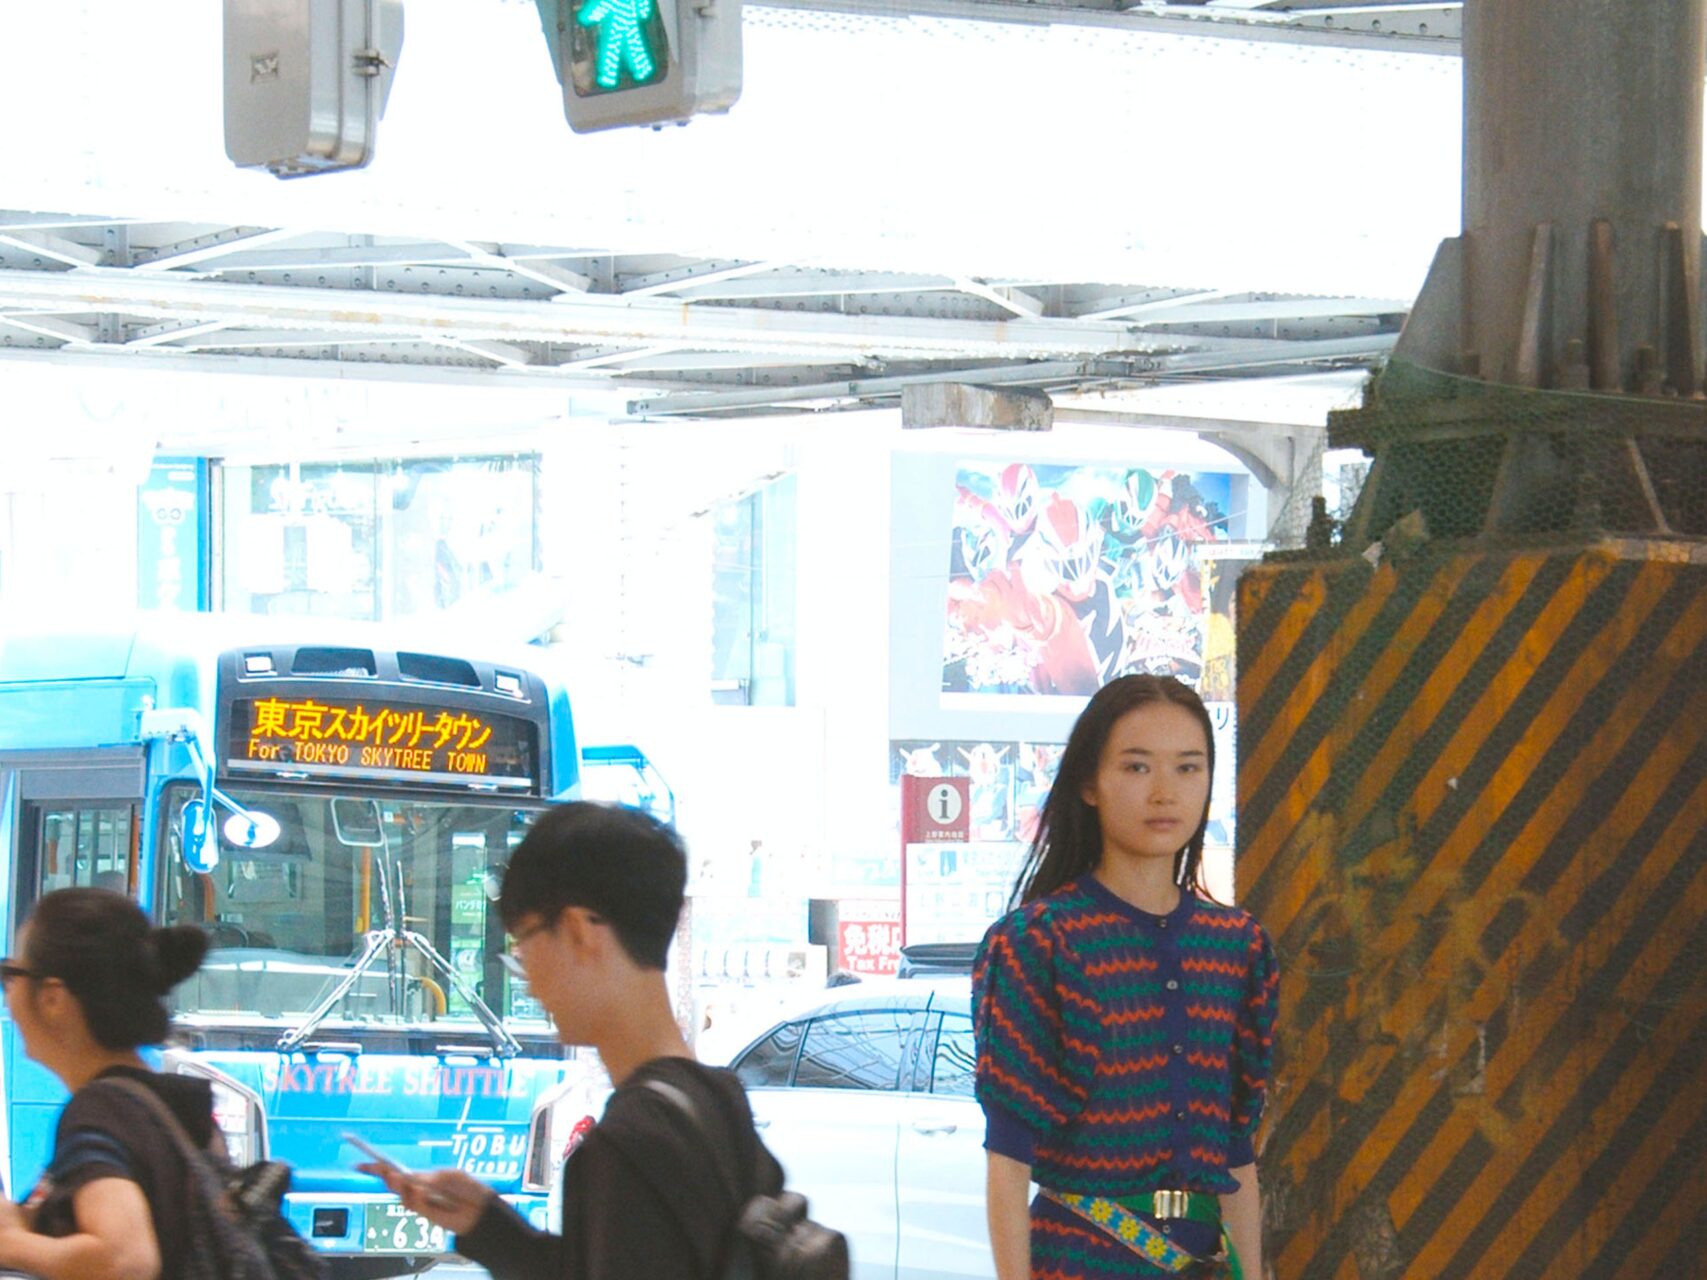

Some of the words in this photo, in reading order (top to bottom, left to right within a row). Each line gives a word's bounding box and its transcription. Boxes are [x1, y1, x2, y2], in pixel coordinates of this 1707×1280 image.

[251, 697, 492, 750] 東京スカイツリータウン
[248, 737, 280, 761] For
[294, 741, 349, 765] TOKYO
[361, 746, 433, 771] SKYTREE
[447, 750, 487, 774] TOWN
[847, 956, 874, 971] Tax
[262, 1062, 391, 1095] SKYTREE
[403, 1064, 529, 1098] SHUTTLE
[451, 1133, 527, 1156] TOBU
[465, 1157, 519, 1175] Group
